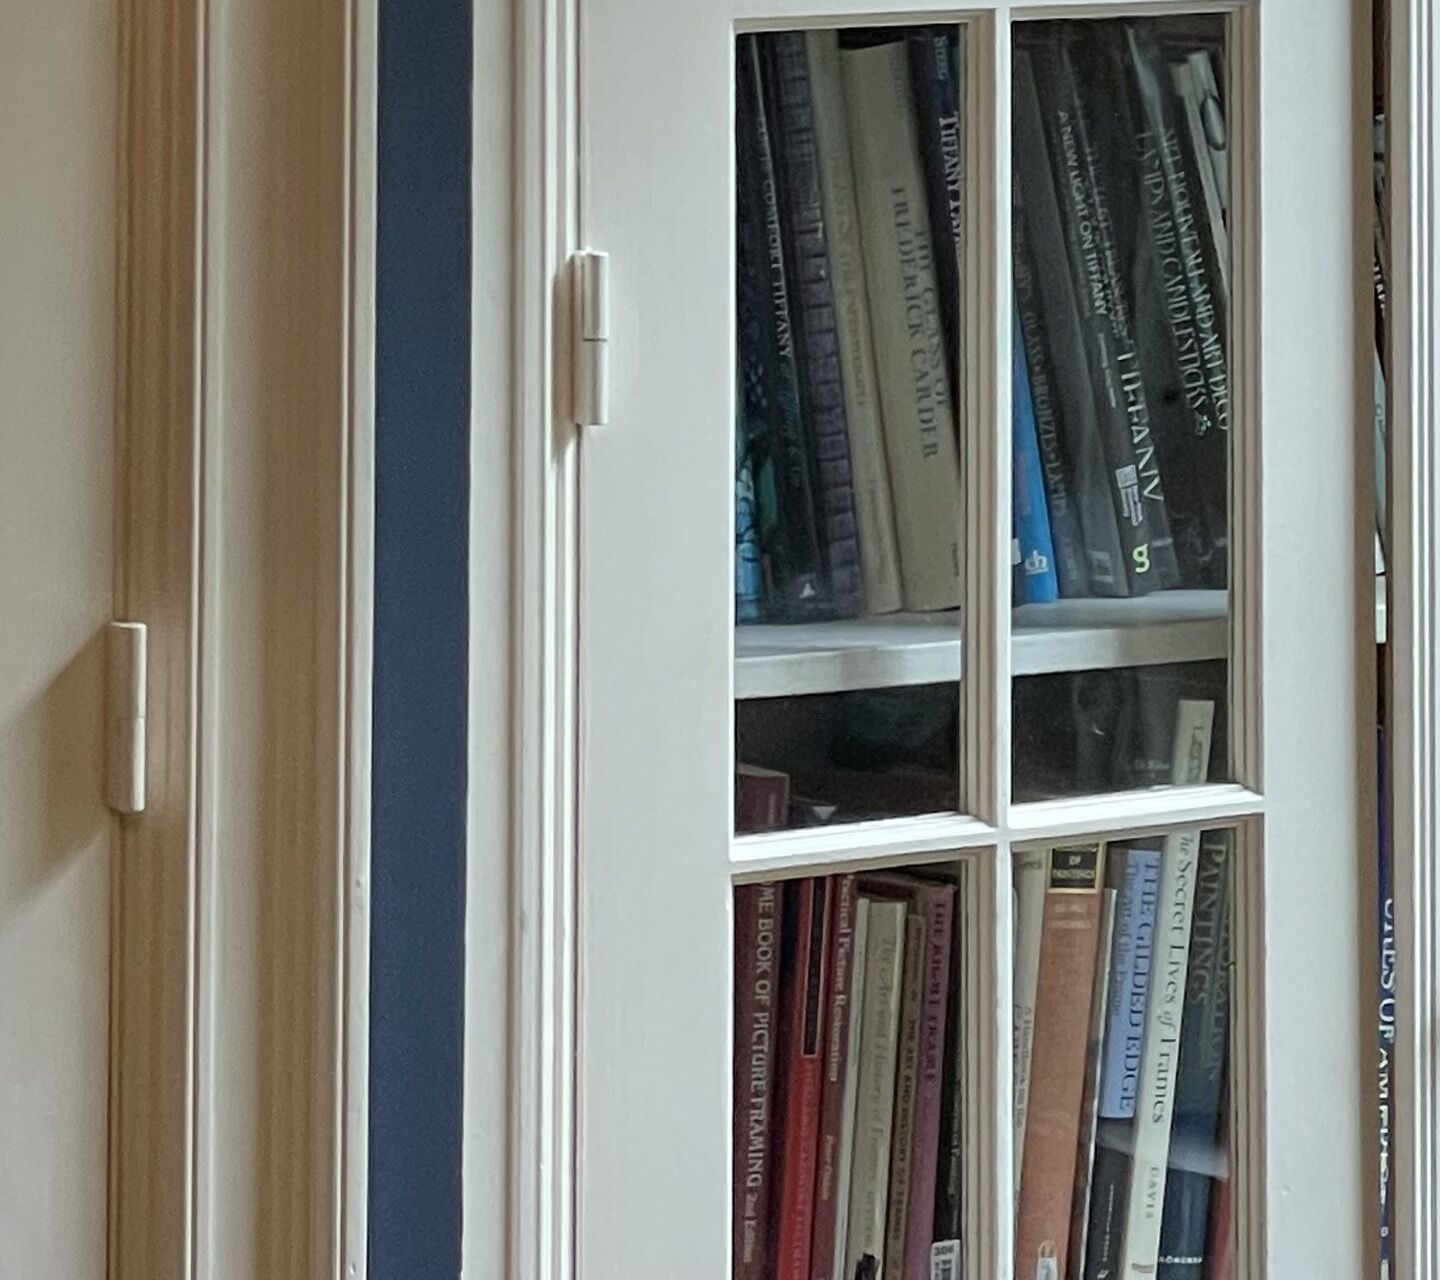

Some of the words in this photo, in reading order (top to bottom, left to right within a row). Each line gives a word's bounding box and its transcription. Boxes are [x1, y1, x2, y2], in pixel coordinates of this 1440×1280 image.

[1057, 109, 1069, 124] A
[1061, 125, 1079, 167] NEW
[938, 110, 961, 192] TIFFANY
[1070, 170, 1090, 217] LIGHT
[1079, 221, 1095, 251] ON
[1151, 210, 1177, 256] AND
[1085, 251, 1108, 316] TIFFANY
[1190, 283, 1215, 330] AND
[772, 277, 792, 358] TIFFANY
[891, 186, 920, 339] FREDERICK
[911, 348, 939, 460] CARDER
[1162, 256, 1209, 410] CANDLESTICKS
[1199, 330, 1224, 368] ART
[1117, 350, 1164, 502] TIFFANY
[1180, 836, 1194, 856] he
[839, 876, 856, 934] ractical
[1139, 864, 1160, 915] THE
[1171, 860, 1193, 932] Secret
[756, 917, 774, 974] BOOK
[1191, 842, 1227, 1005] PAINTINGS
[754, 979, 771, 1007] OF
[834, 936, 851, 991] Picture
[1129, 921, 1151, 1028] GILDED
[1164, 943, 1185, 1005] Lives
[749, 1011, 770, 1090] PICTURE
[1156, 1010, 1177, 1034] of
[1119, 1035, 1142, 1112] EDGE
[1152, 1037, 1177, 1124] Frames
[746, 1096, 767, 1188] FRAMING
